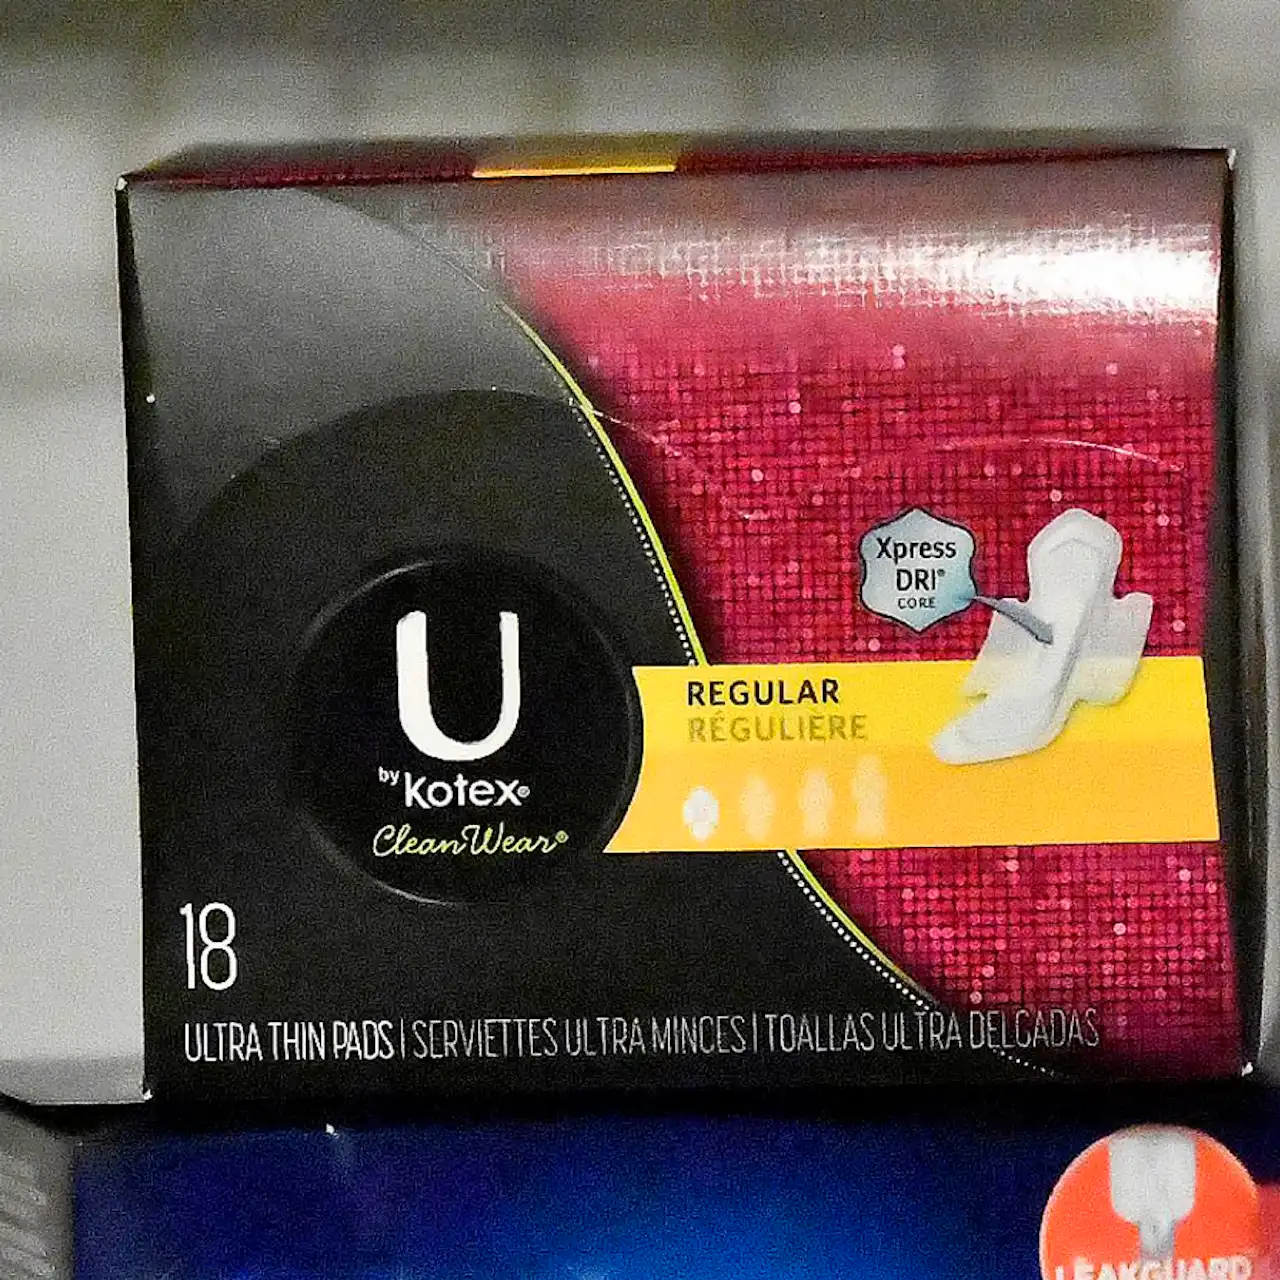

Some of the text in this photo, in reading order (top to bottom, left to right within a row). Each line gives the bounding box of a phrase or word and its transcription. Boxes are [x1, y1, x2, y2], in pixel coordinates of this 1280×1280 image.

[876, 536, 957, 561] Xpress
[897, 596, 936, 610] CORE
[396, 610, 521, 762] U
[687, 677, 840, 706] REGULAR
[687, 709, 868, 744] RÉGULIÈRE
[378, 766, 521, 810] by Kotex
[179, 902, 238, 991] 18
[183, 1006, 1100, 1063] ULTRA THIN PADS SERVIETTES ULTRA MINCES TOALLAS ULTRA DELGADAS
